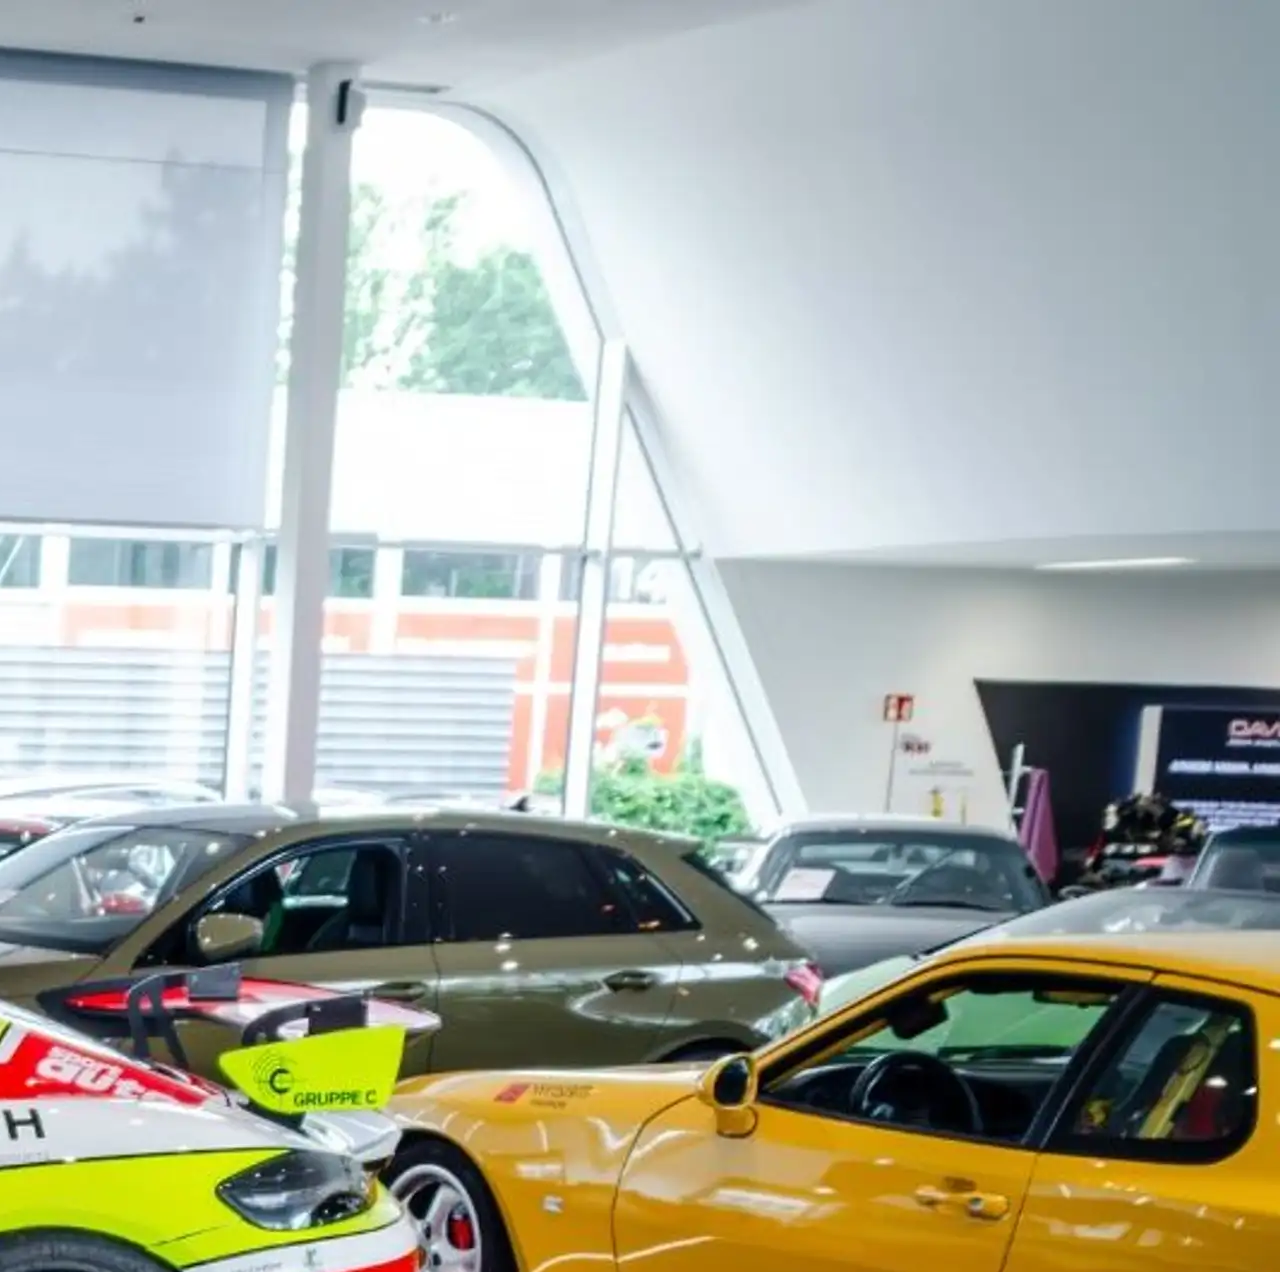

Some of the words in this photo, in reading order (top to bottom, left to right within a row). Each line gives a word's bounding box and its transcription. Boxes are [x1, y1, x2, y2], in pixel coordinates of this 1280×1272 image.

[1228, 719, 1280, 738] DAV
[293, 1089, 363, 1107] GRUPPE
[365, 1089, 378, 1104] C
